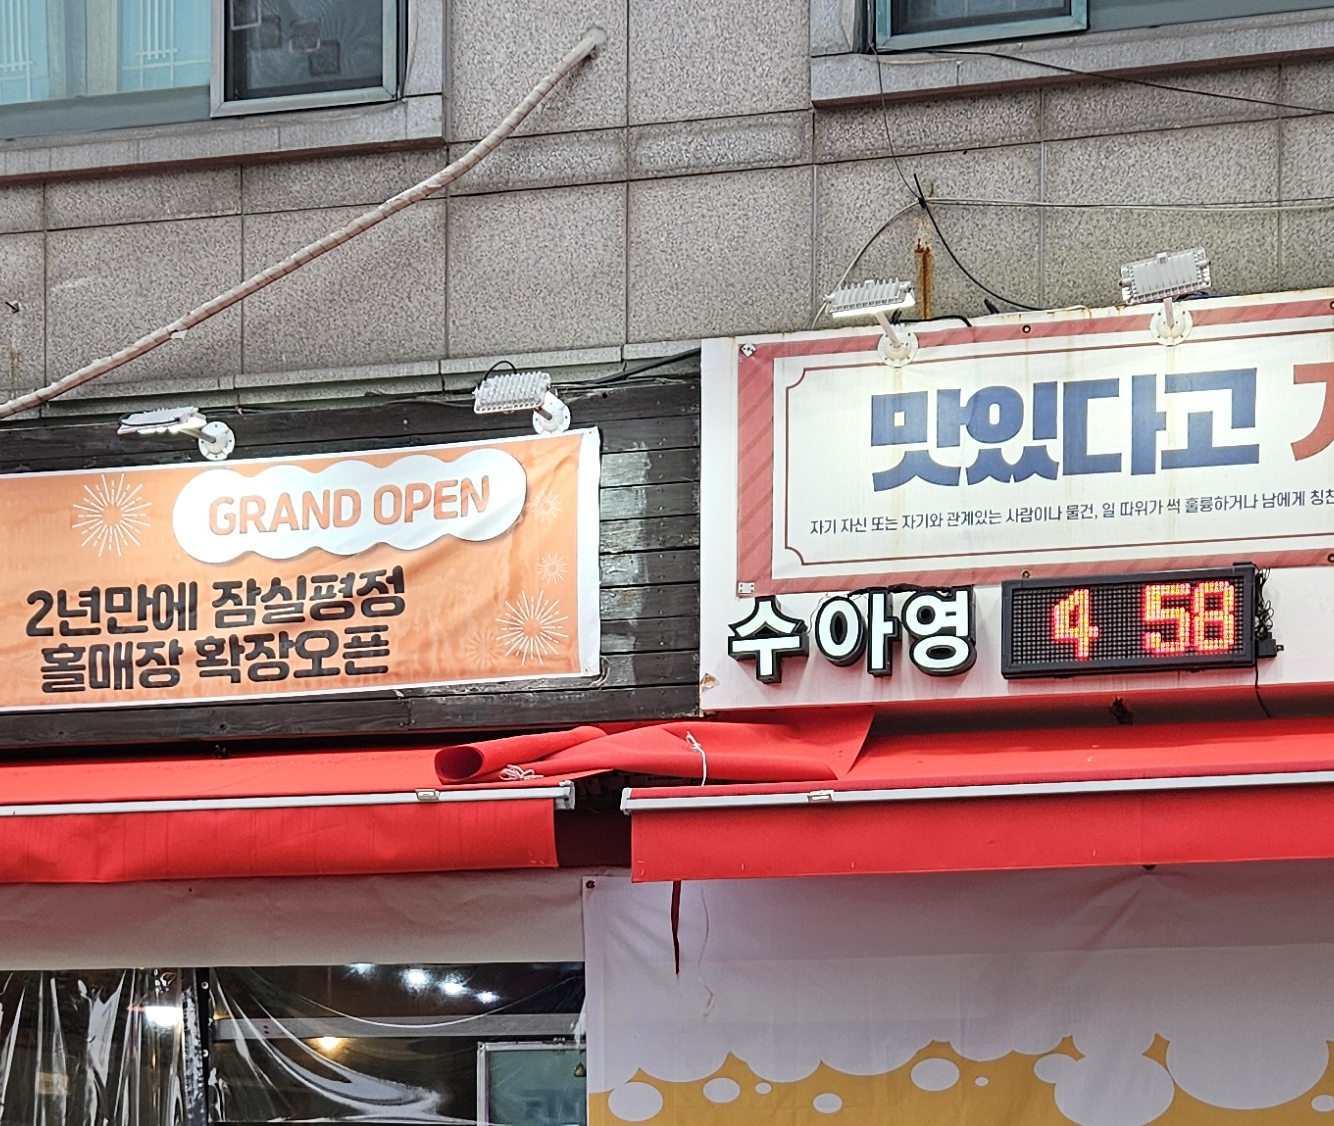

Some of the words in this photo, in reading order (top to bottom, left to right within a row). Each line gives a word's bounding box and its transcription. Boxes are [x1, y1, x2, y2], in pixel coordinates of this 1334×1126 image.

[871, 367, 1260, 492] 맛있다고
[208, 484, 366, 536] GRAND
[372, 474, 491, 524] OPEN
[810, 519, 837, 535] 자기
[840, 517, 867, 533] 자신
[871, 515, 898, 531] 또는
[901, 512, 943, 530] 자기와
[946, 509, 1002, 527] 관계있는
[1005, 505, 1062, 523] 사람이나
[1066, 503, 1098, 520] 물건,
[1102, 501, 1115, 518] 일
[1120, 499, 1164, 517] 따위가
[1167, 497, 1181, 515] 썩
[1185, 494, 1259, 514] 훌륭하거나
[1261, 490, 1306, 509] 남에게
[26, 580, 198, 638] 2년만에
[212, 565, 406, 628] 잠실평정
[728, 586, 976, 684] 수아영
[1050, 588, 1100, 660] 4
[1142, 581, 1236, 656] 58
[39, 636, 181, 695] 홀매장
[193, 624, 391, 684] 확장오픈
